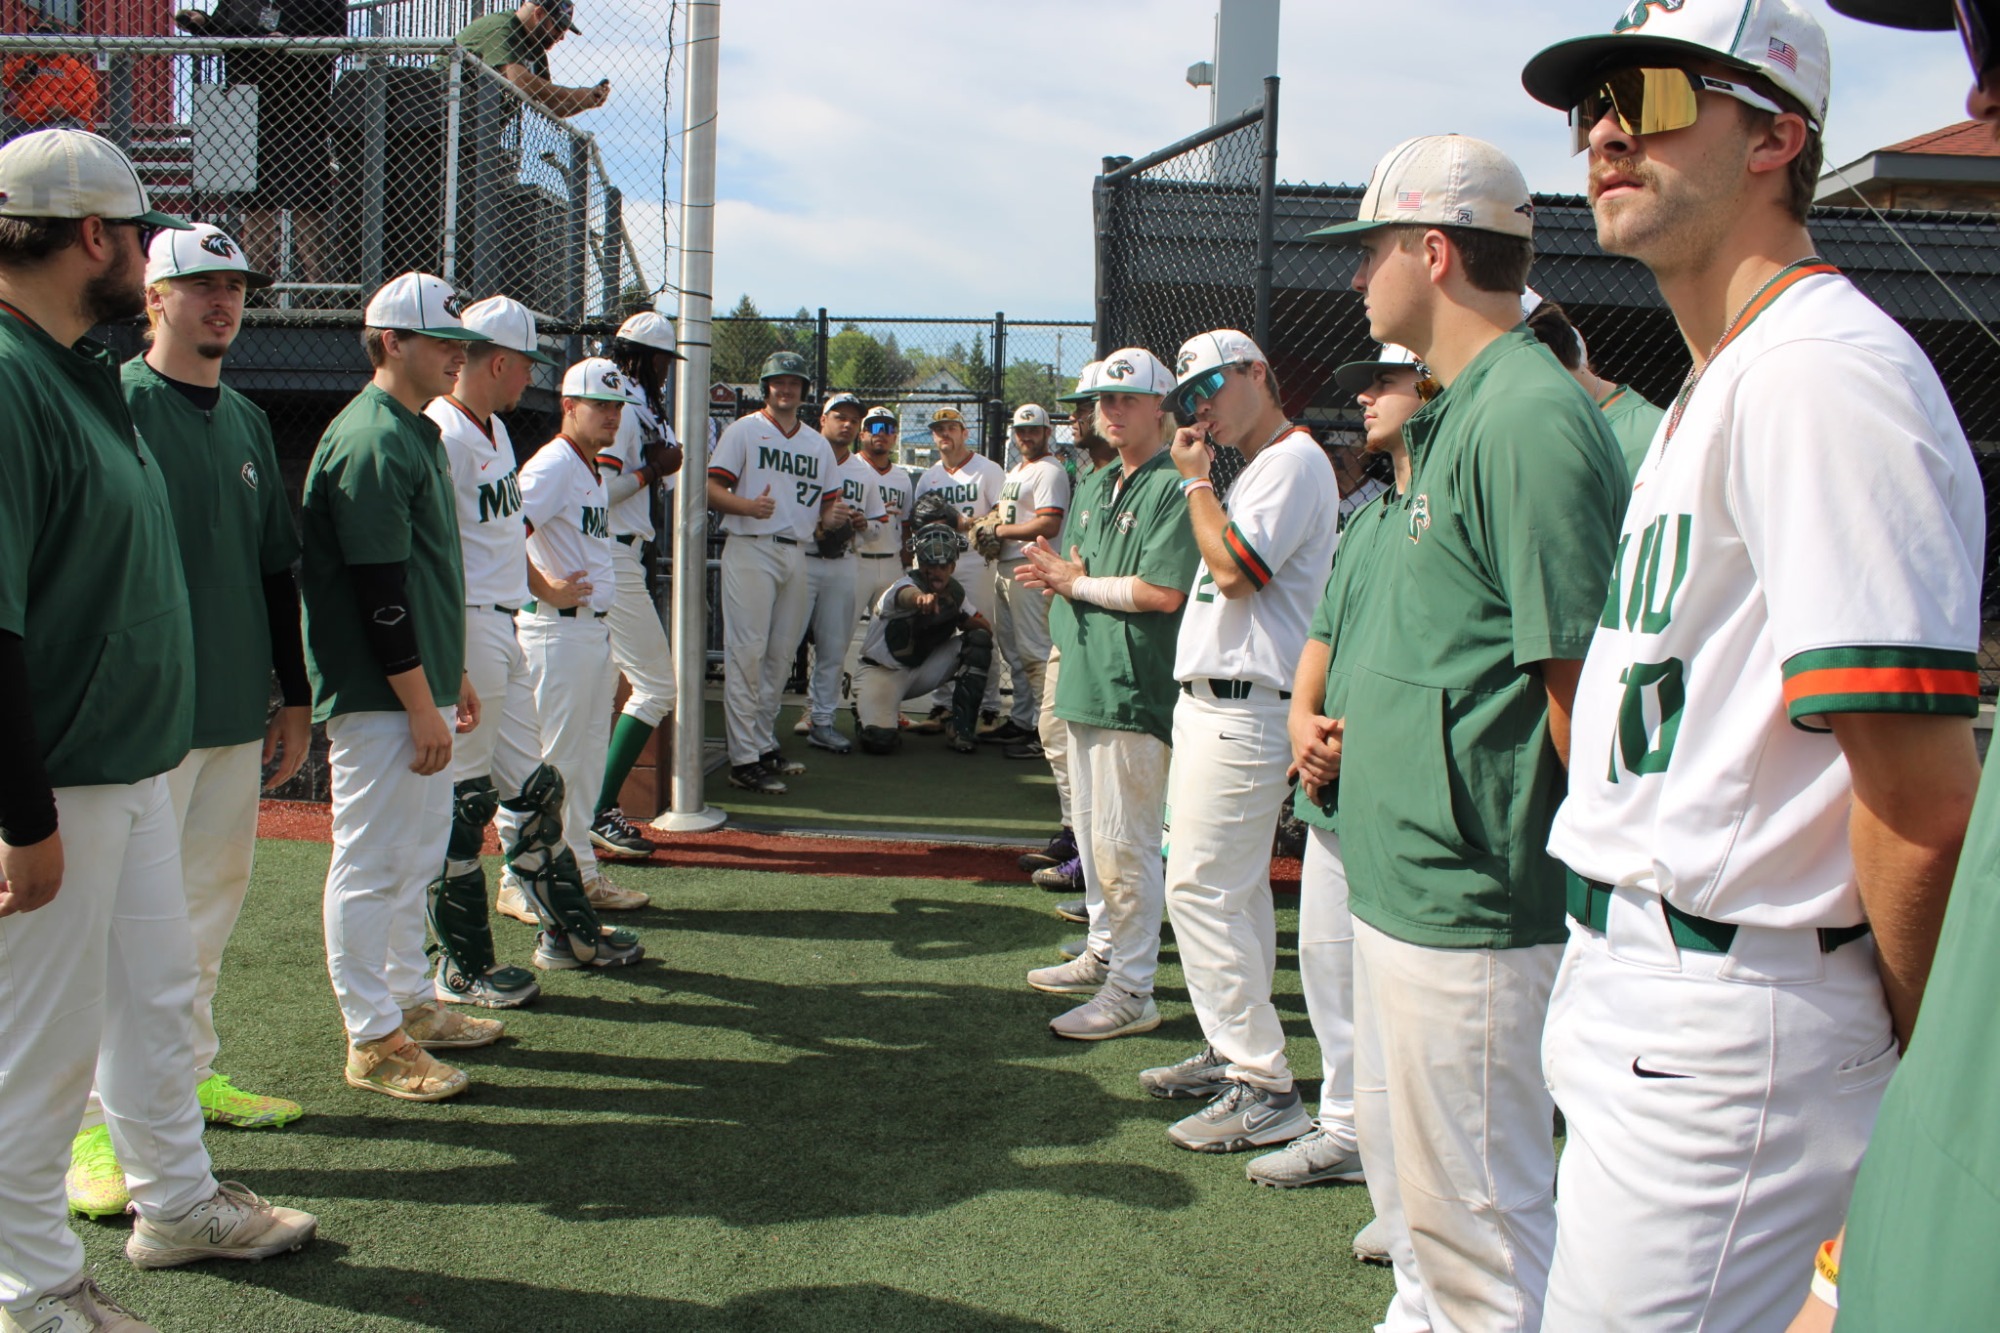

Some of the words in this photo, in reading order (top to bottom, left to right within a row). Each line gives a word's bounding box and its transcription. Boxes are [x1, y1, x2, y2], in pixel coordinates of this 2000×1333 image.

[758, 446, 818, 479] MACU
[796, 481, 822, 507] 27
[843, 479, 864, 503] CU
[878, 485, 905, 509] ACU
[581, 506, 609, 538] MA
